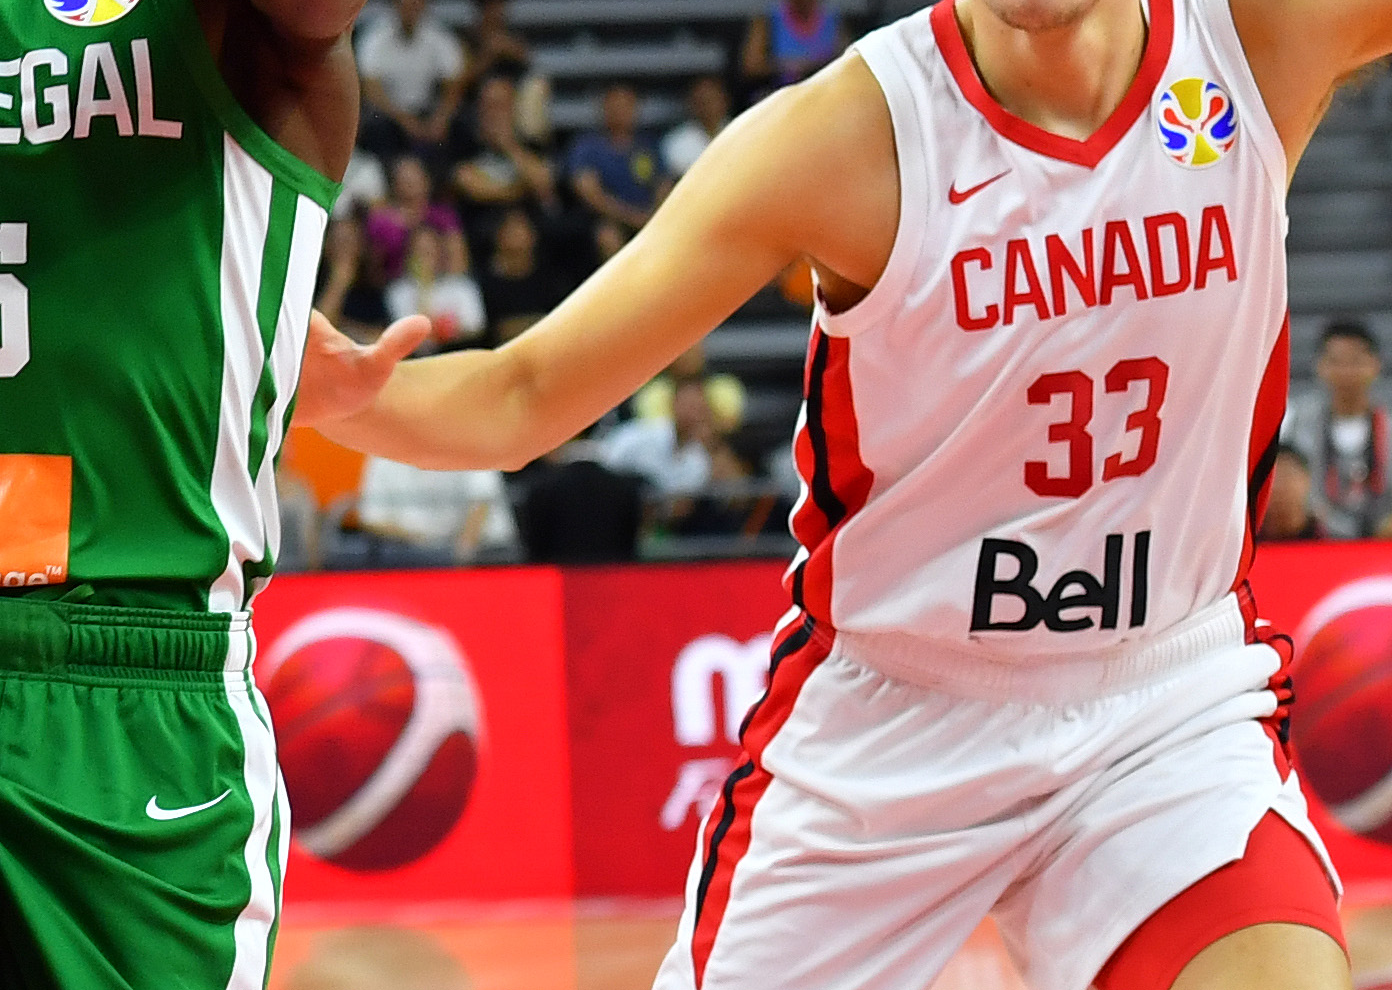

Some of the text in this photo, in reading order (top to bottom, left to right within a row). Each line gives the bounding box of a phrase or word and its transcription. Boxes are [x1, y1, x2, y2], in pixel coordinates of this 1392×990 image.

[951, 205, 1237, 332] CANADA
[1024, 356, 1170, 499] 33
[969, 530, 1151, 633] Bell
